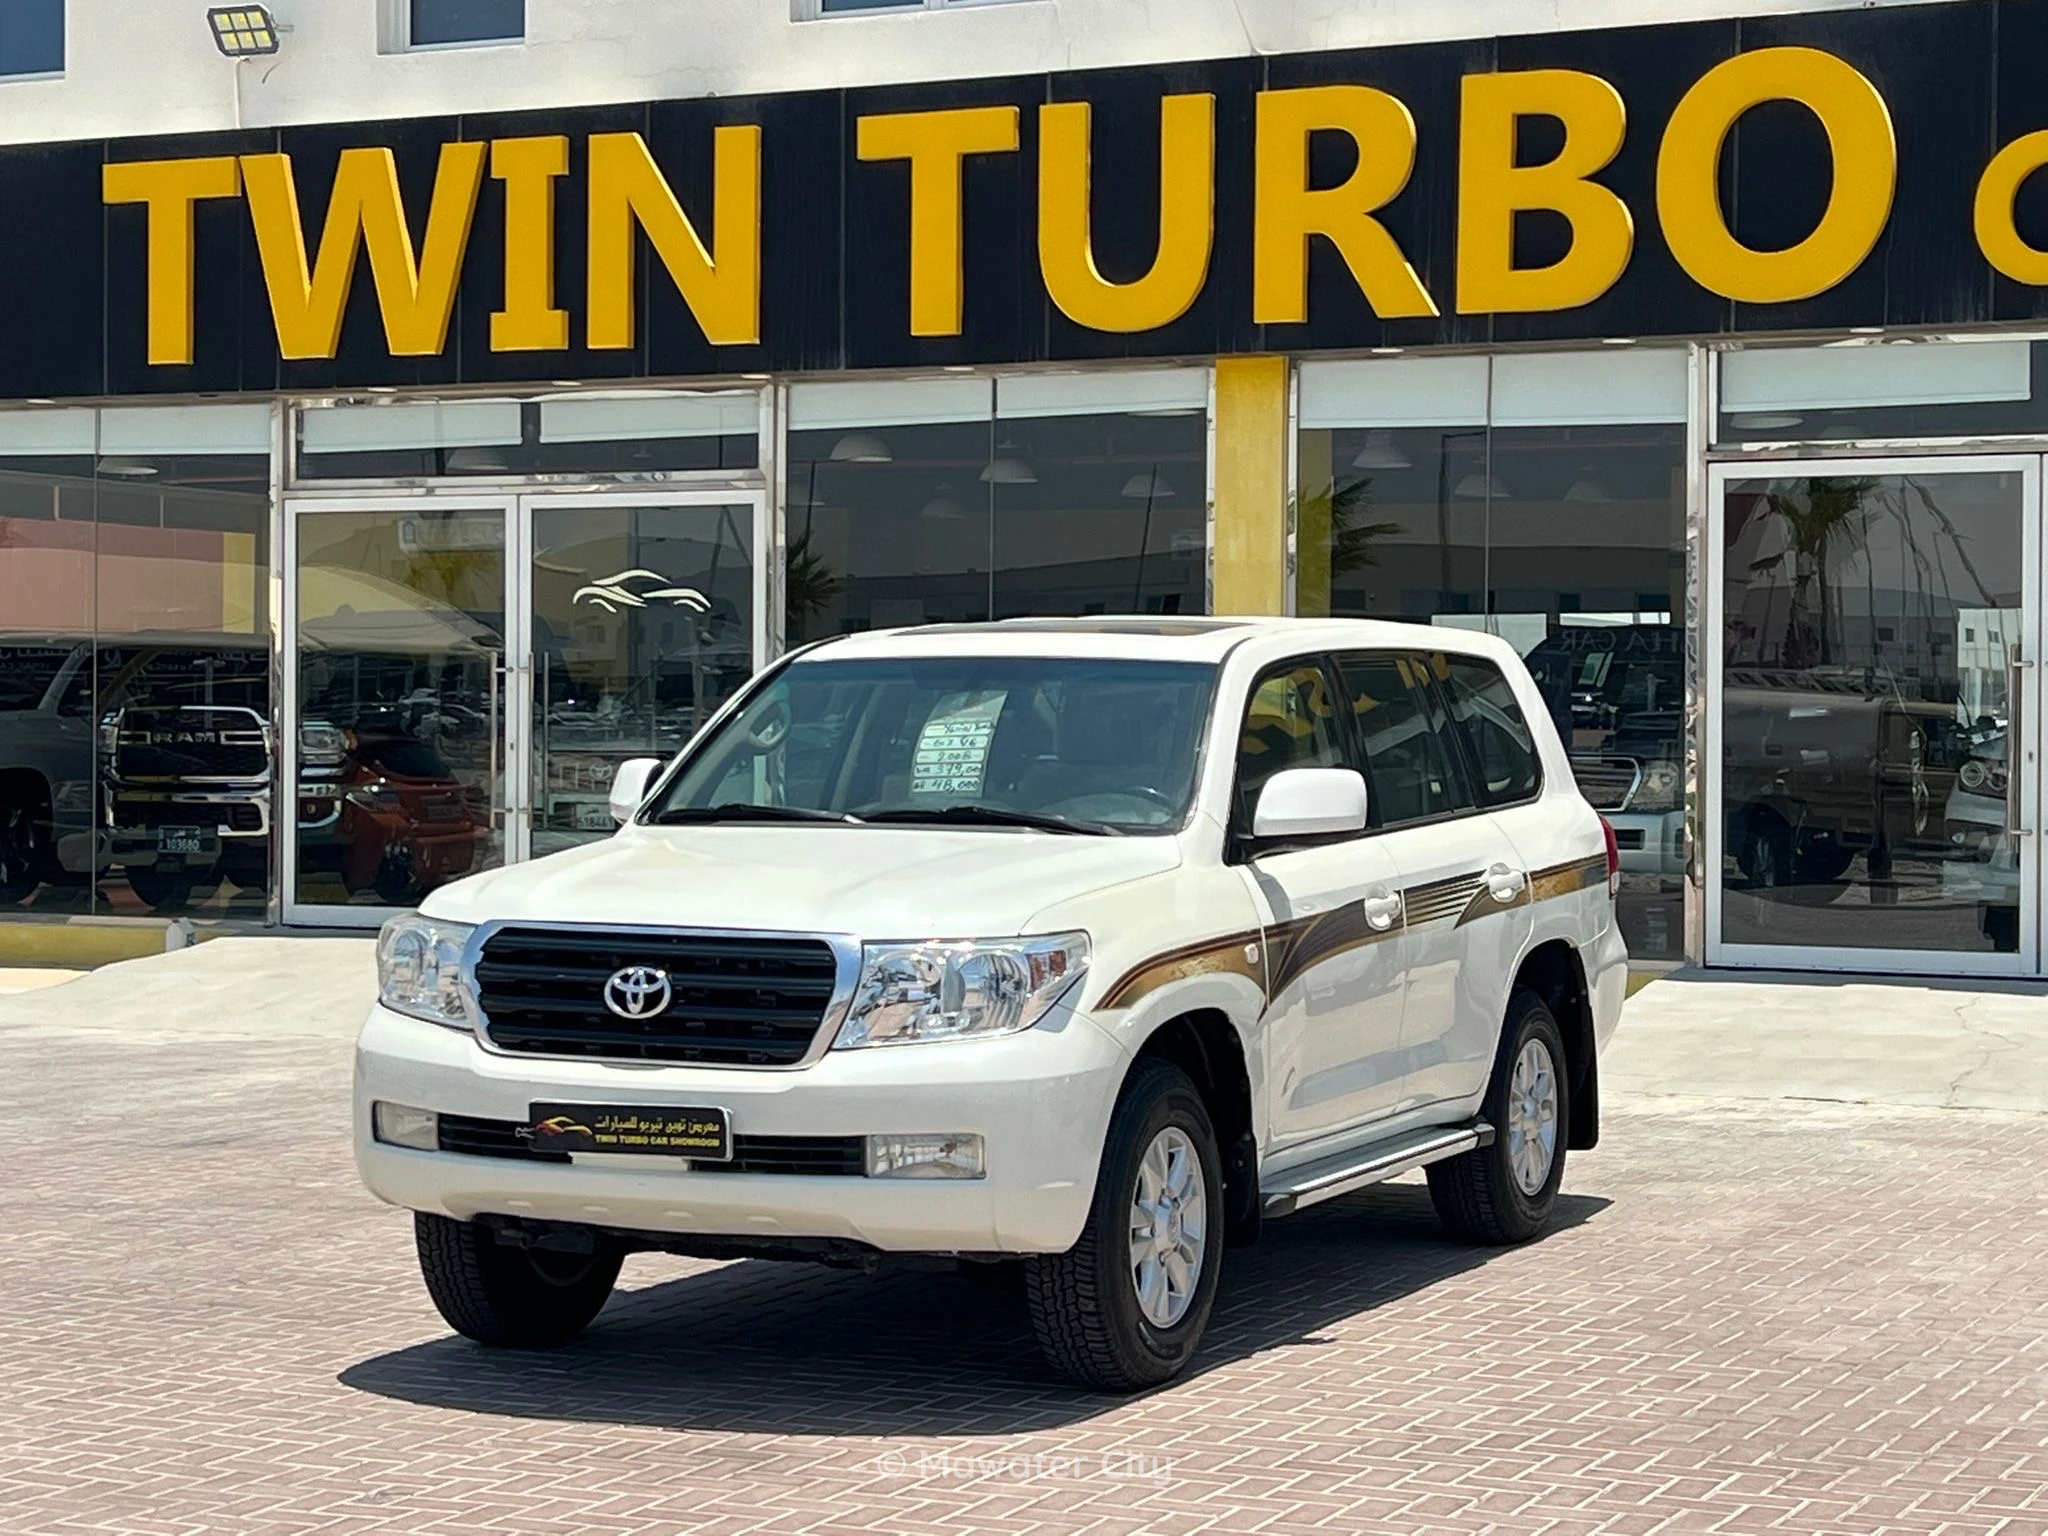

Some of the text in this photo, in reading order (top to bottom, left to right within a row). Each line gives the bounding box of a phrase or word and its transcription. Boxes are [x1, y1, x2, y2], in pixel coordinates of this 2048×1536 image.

[102, 125, 762, 365] TWIN
[856, 45, 1897, 338] TURBO
[152, 731, 216, 743] RAM
[595, 1134, 720, 1147] TWIN TURBO CAR SHOWROOM
